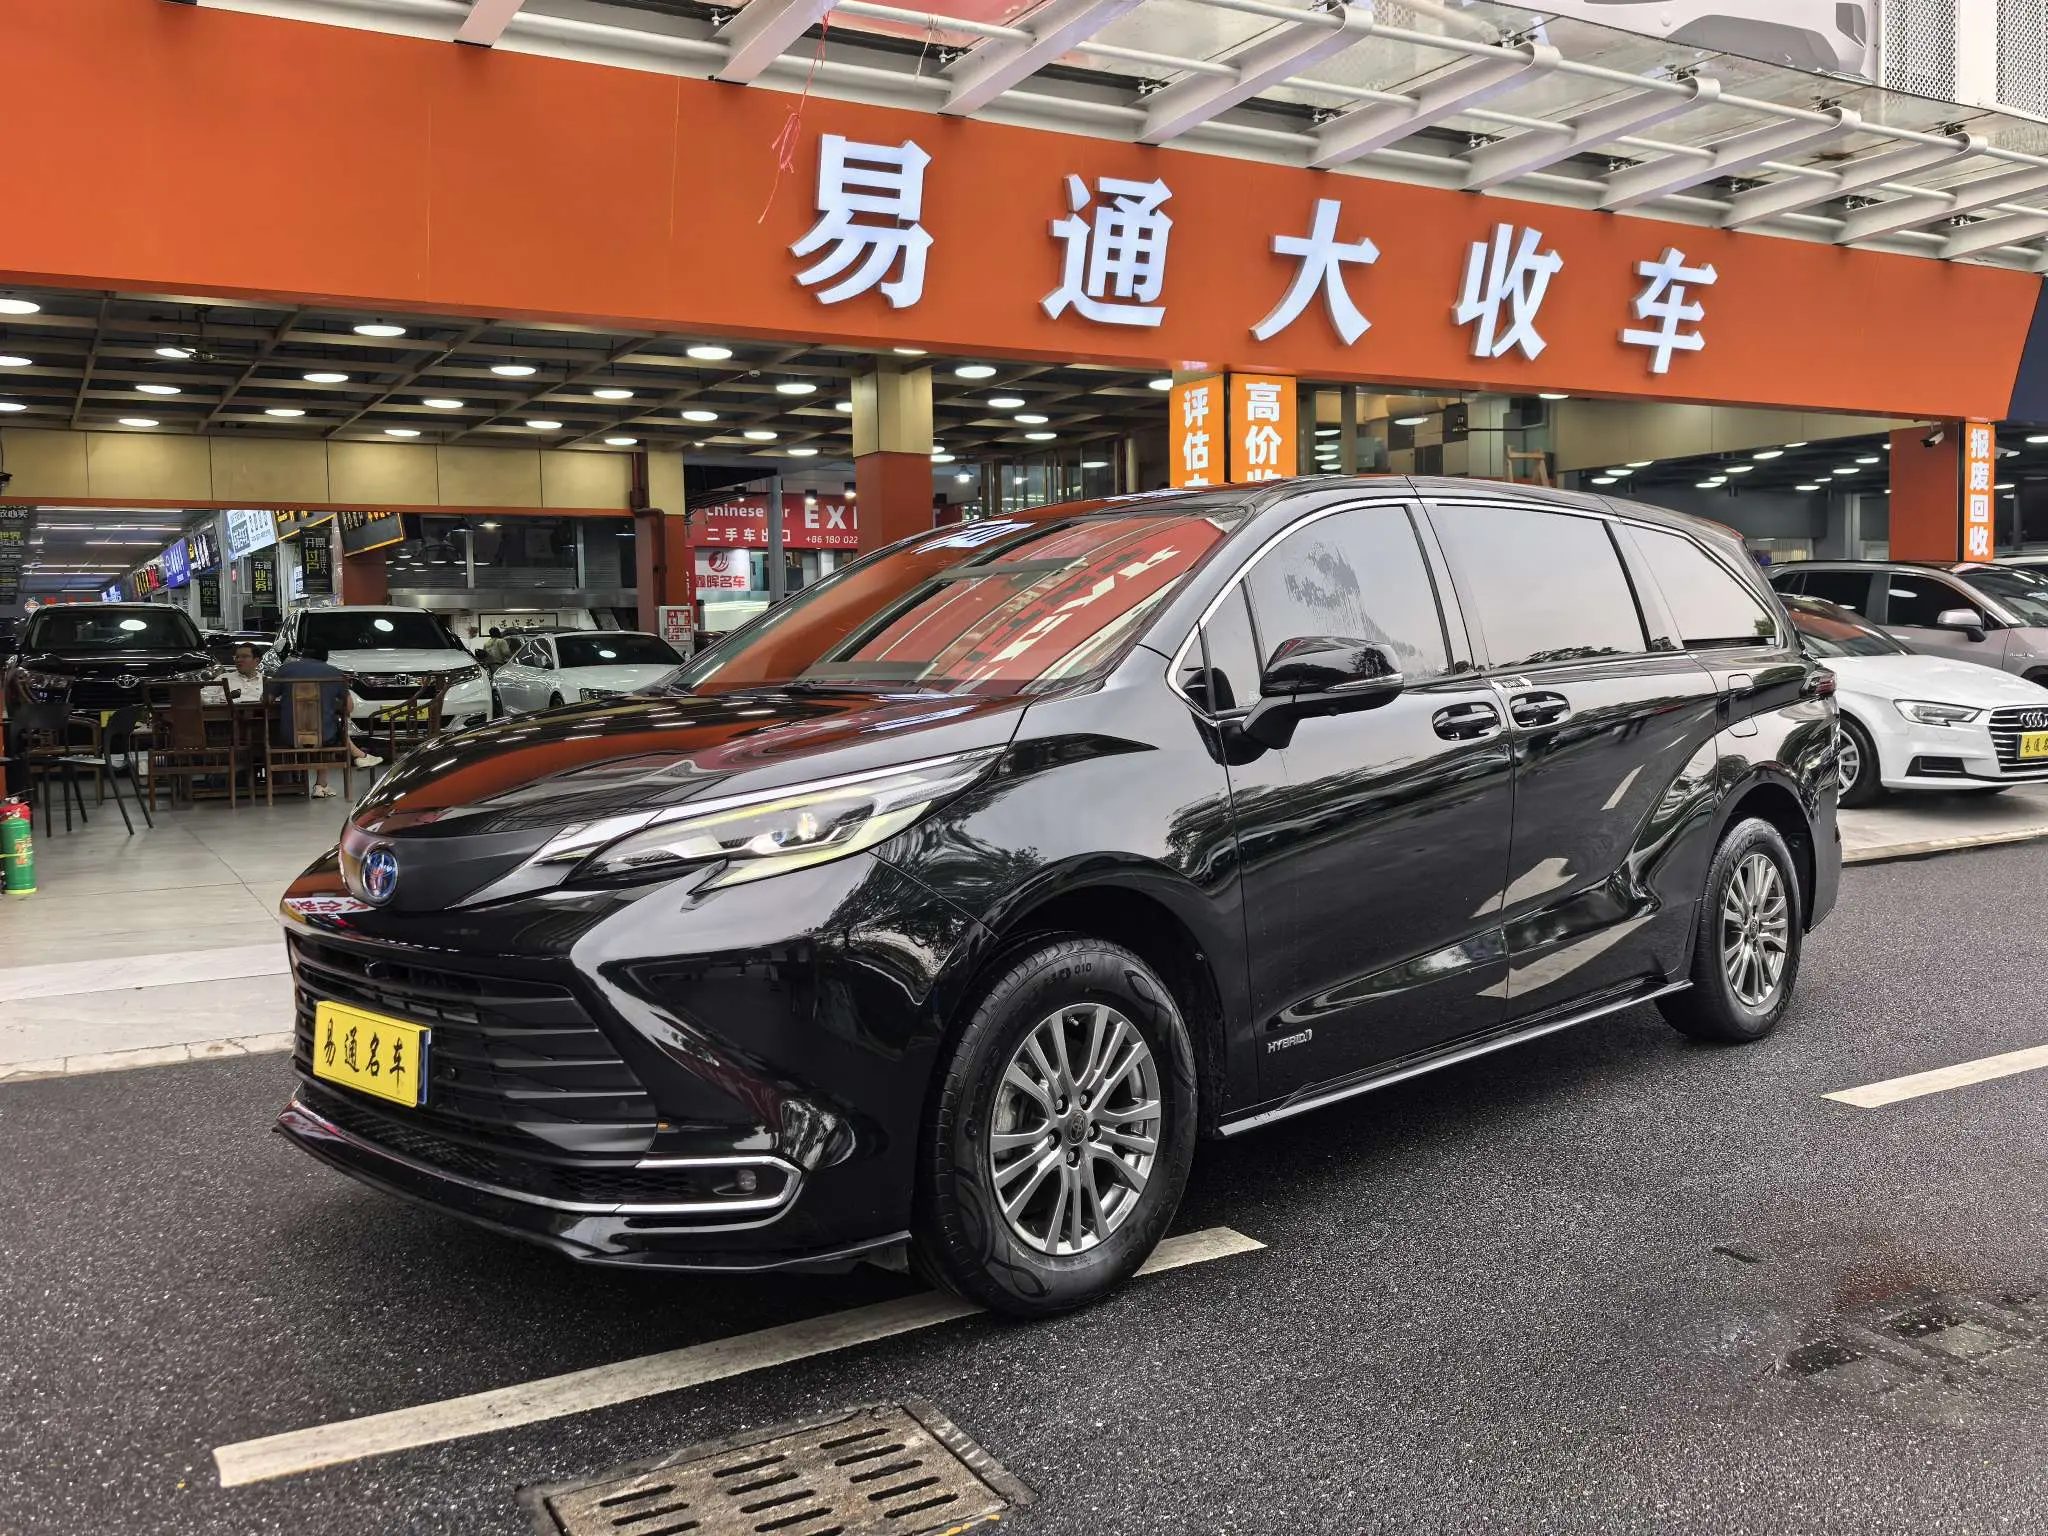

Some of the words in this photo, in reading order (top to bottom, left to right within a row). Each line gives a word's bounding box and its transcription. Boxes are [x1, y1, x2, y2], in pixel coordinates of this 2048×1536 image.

[787, 133, 1718, 376] 易通大收车
[804, 504, 858, 530] EX
